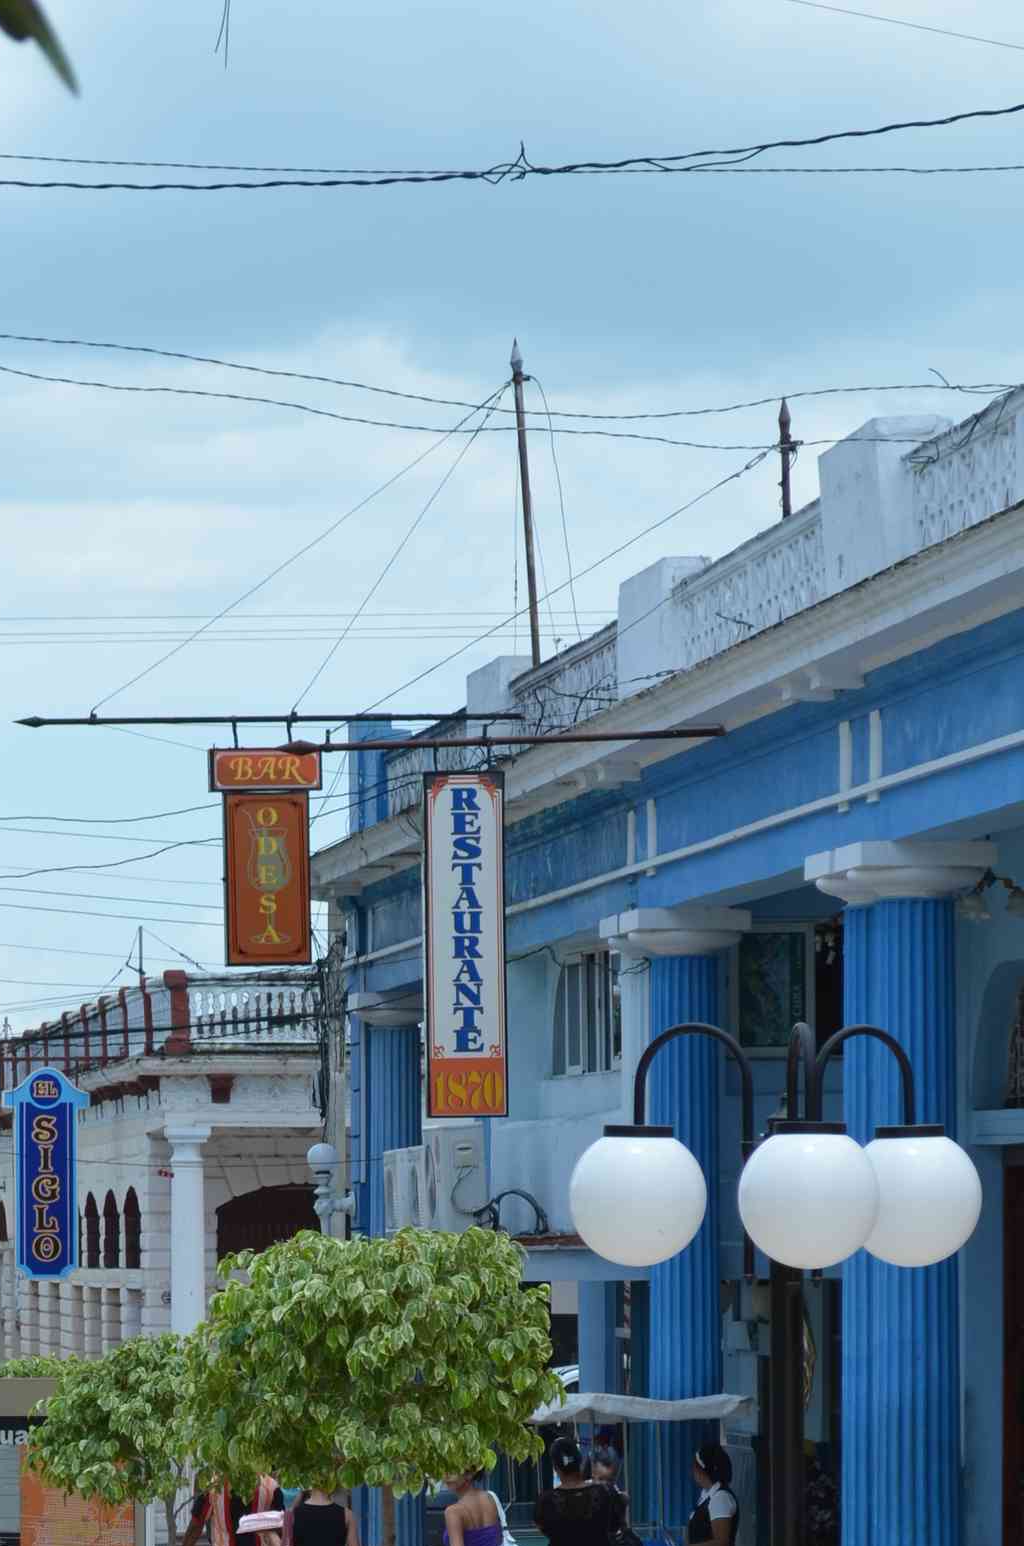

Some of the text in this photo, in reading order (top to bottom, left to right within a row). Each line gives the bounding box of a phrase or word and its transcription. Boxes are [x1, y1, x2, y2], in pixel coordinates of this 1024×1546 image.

[230, 757, 308, 785] BAR
[257, 807, 281, 943] ODESA
[450, 787, 484, 1053] RESTAURANTE
[33, 1081, 58, 1098] EL
[433, 1071, 503, 1111] 1870
[31, 1115, 62, 1263] SIGLO
